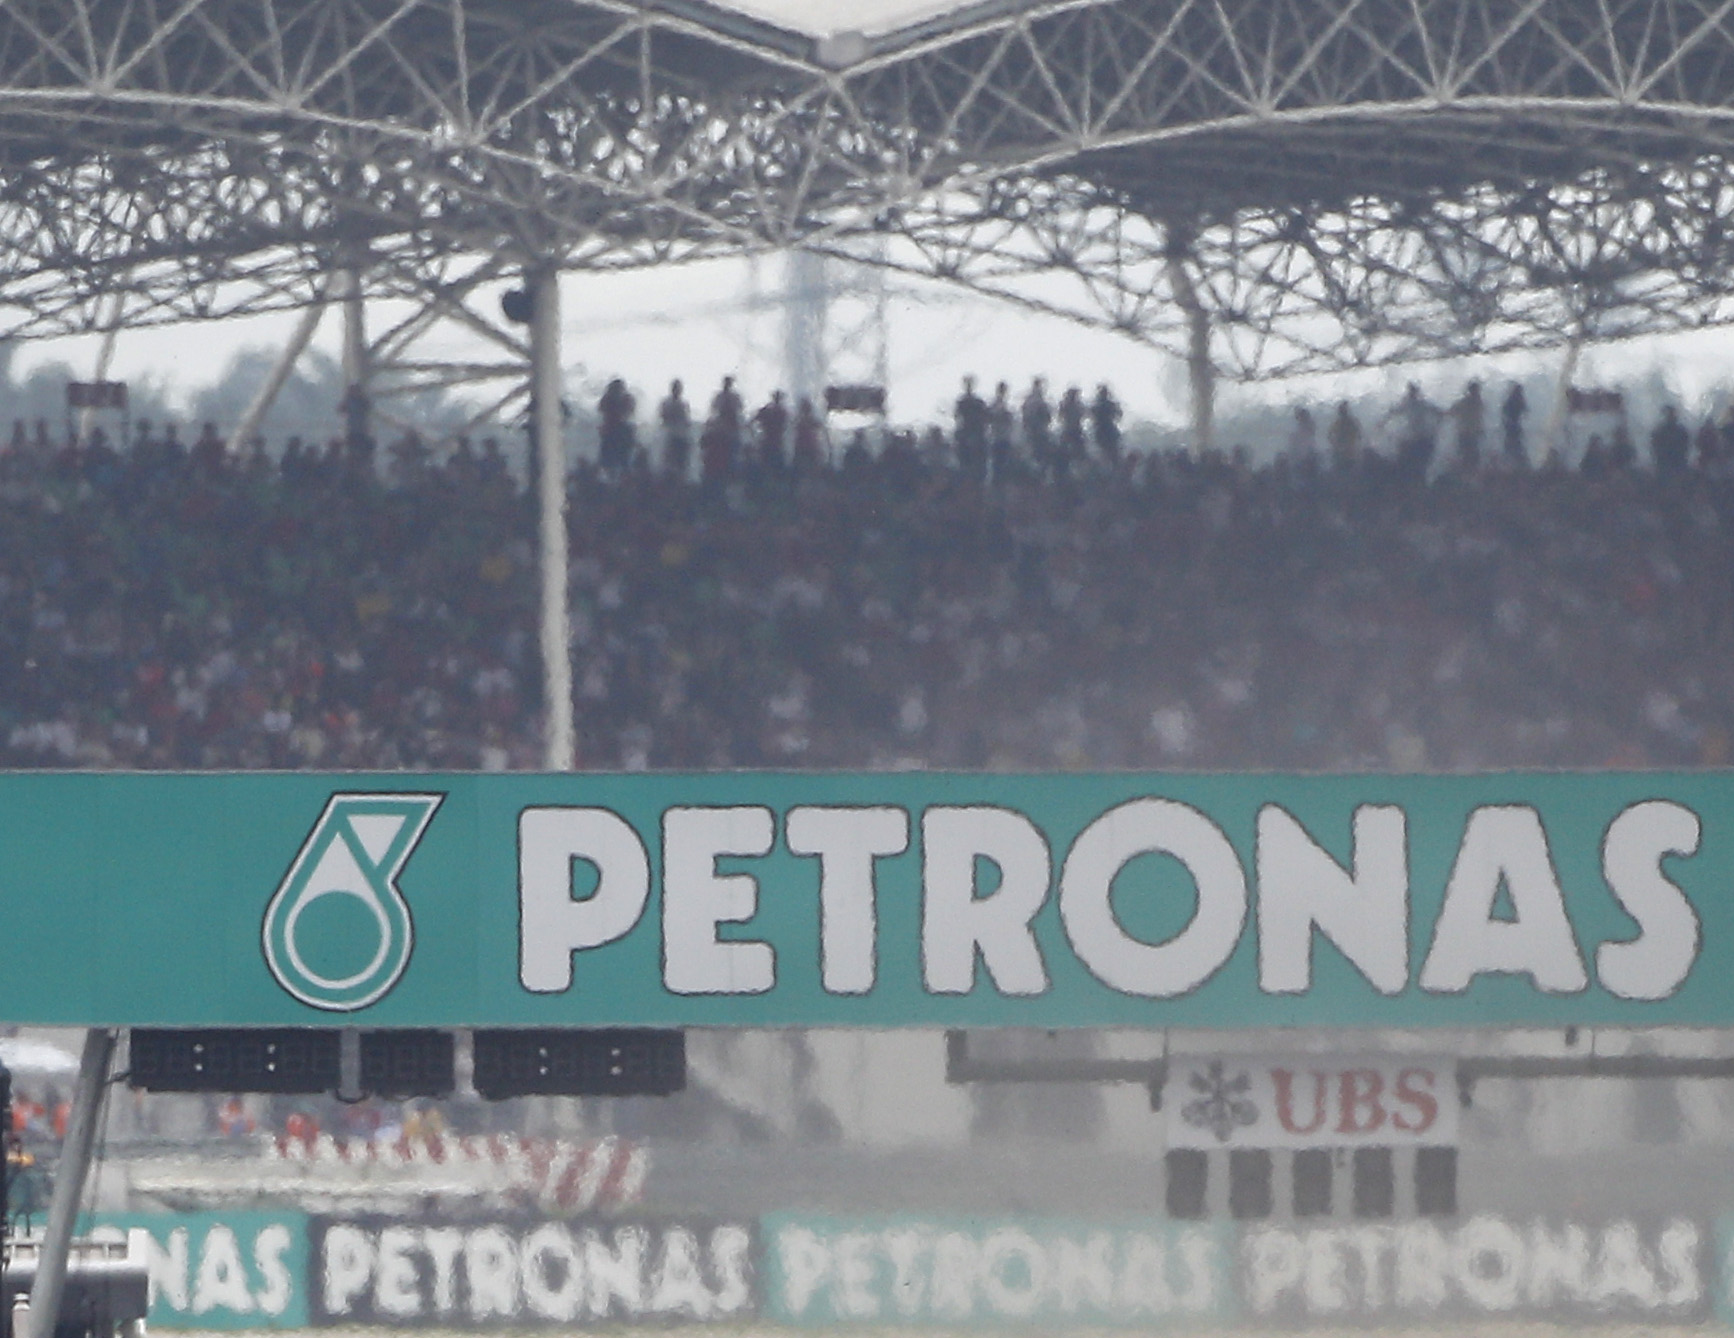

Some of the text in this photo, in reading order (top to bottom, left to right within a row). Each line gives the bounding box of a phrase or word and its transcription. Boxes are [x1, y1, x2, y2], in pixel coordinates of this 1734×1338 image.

[517, 796, 1701, 1000] PETRONAS
[1270, 1067, 1438, 1135] UBS
[321, 1220, 752, 1322] PETRONAS
[777, 1222, 1221, 1317] PETRONAS
[1244, 1218, 1698, 1317] PETRONAS
